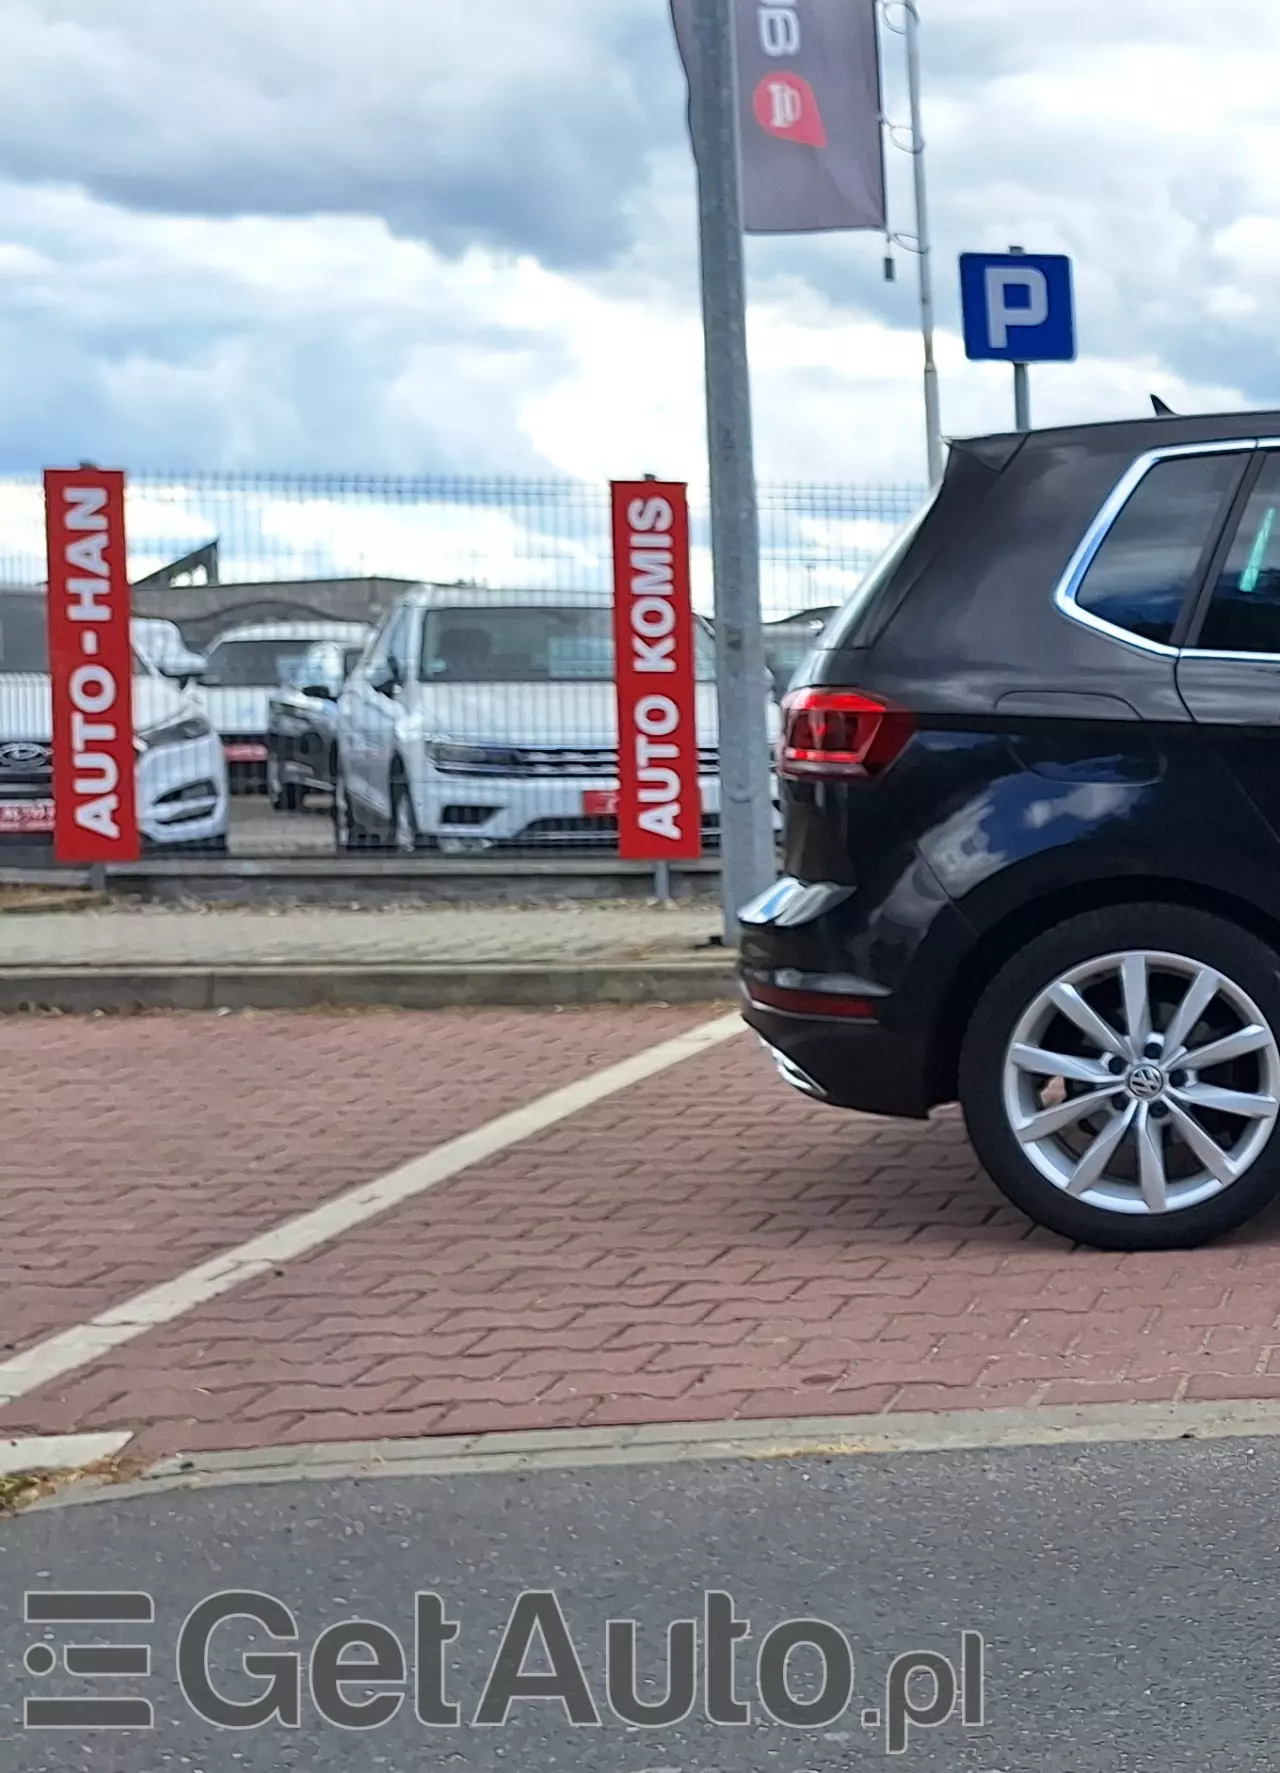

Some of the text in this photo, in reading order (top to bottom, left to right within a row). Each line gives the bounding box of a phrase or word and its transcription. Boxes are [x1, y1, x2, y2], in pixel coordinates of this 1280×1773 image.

[984, 265, 1048, 349] P
[63, 487, 121, 839] AUTO-HAN
[627, 496, 682, 840] AUTO KOMIS
